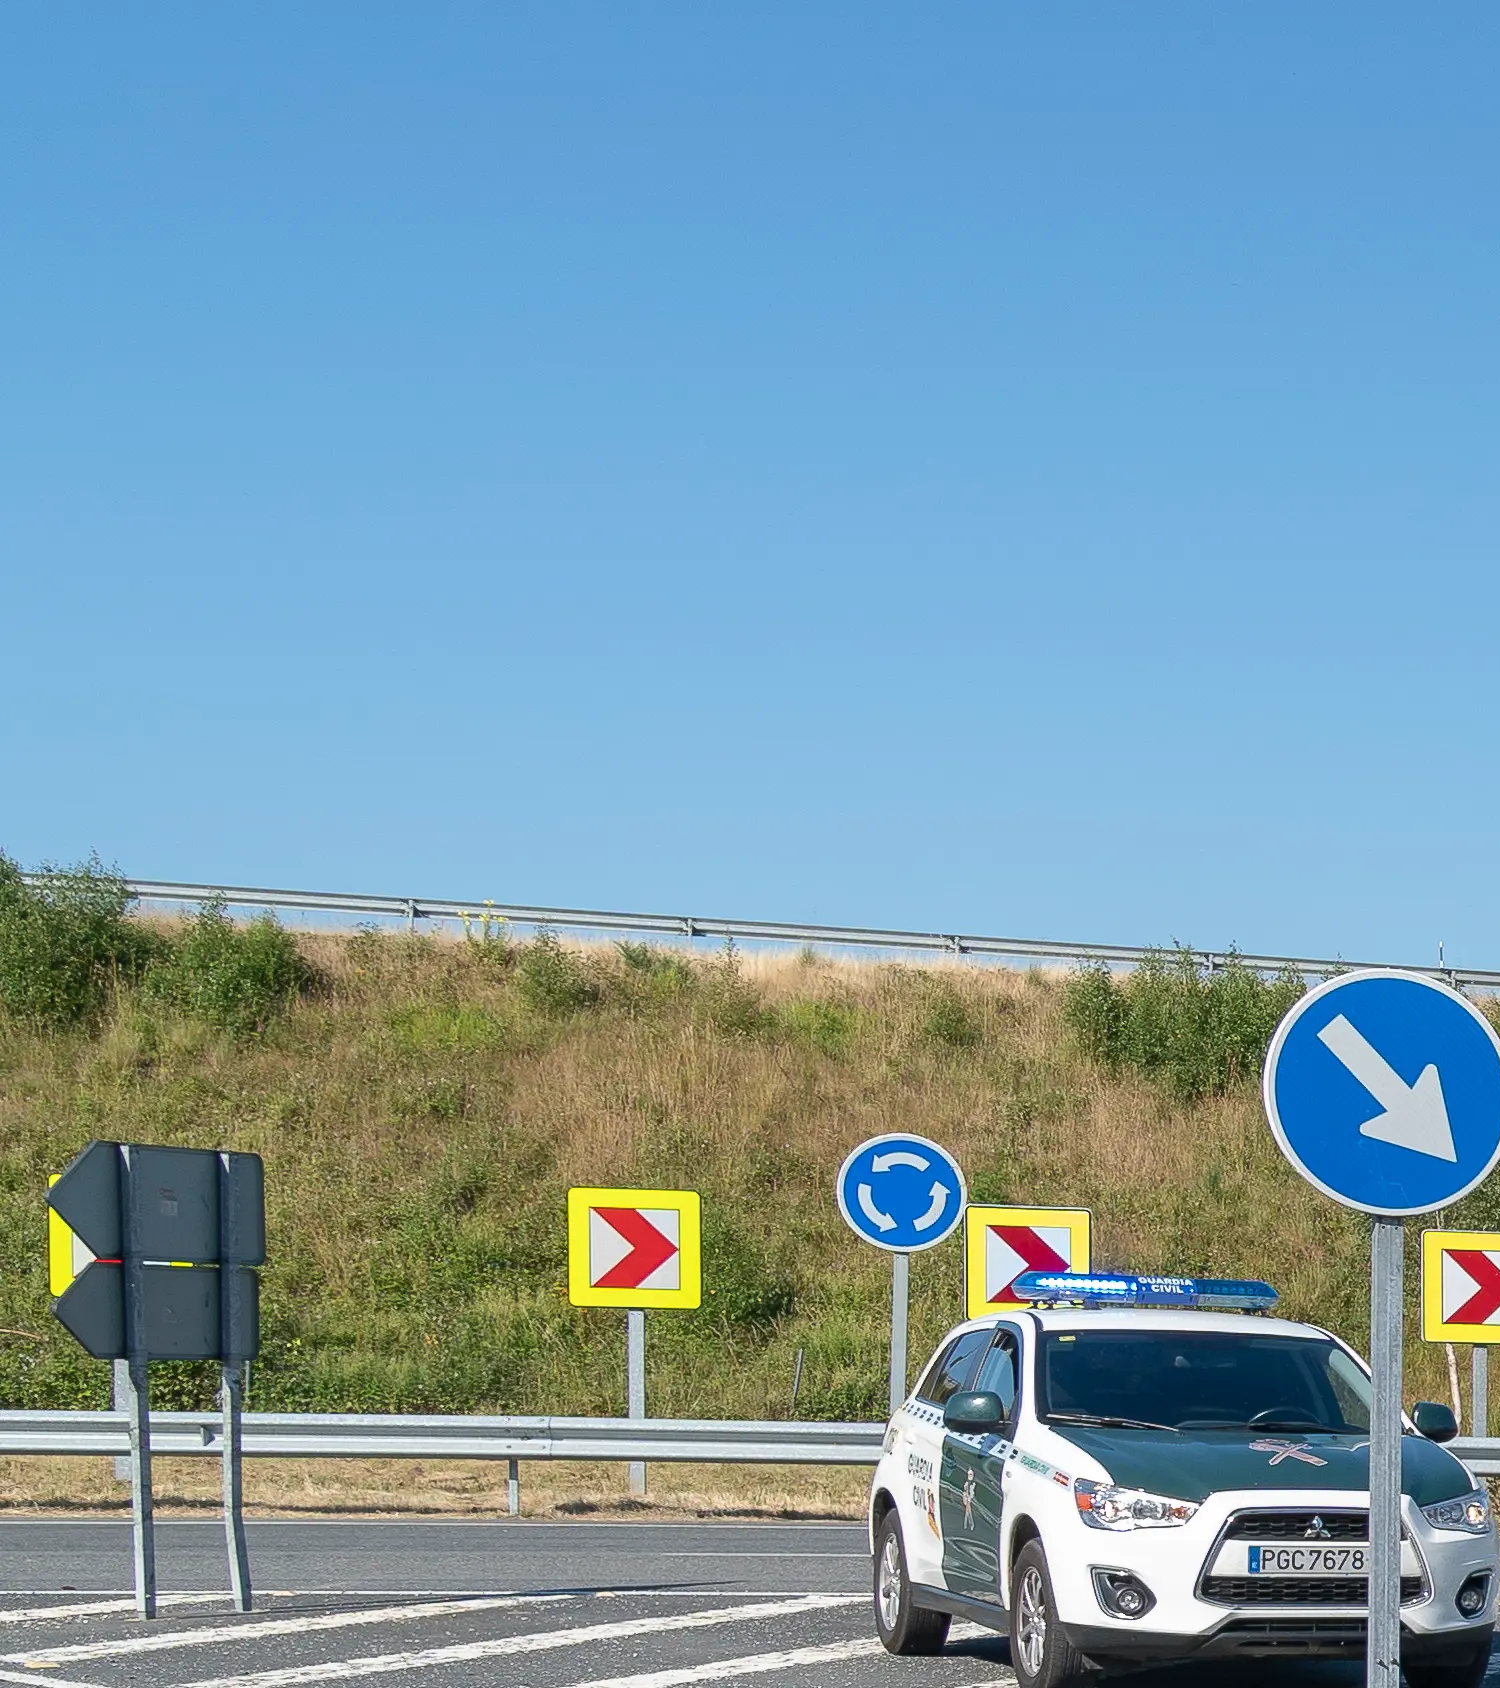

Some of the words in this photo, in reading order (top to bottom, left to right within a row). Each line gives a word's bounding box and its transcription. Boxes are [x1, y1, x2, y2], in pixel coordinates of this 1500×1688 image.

[1138, 1276, 1194, 1286] GUARDIA
[1151, 1284, 1185, 1294] CIVIL
[1261, 1549, 1365, 1571] PGC7678
